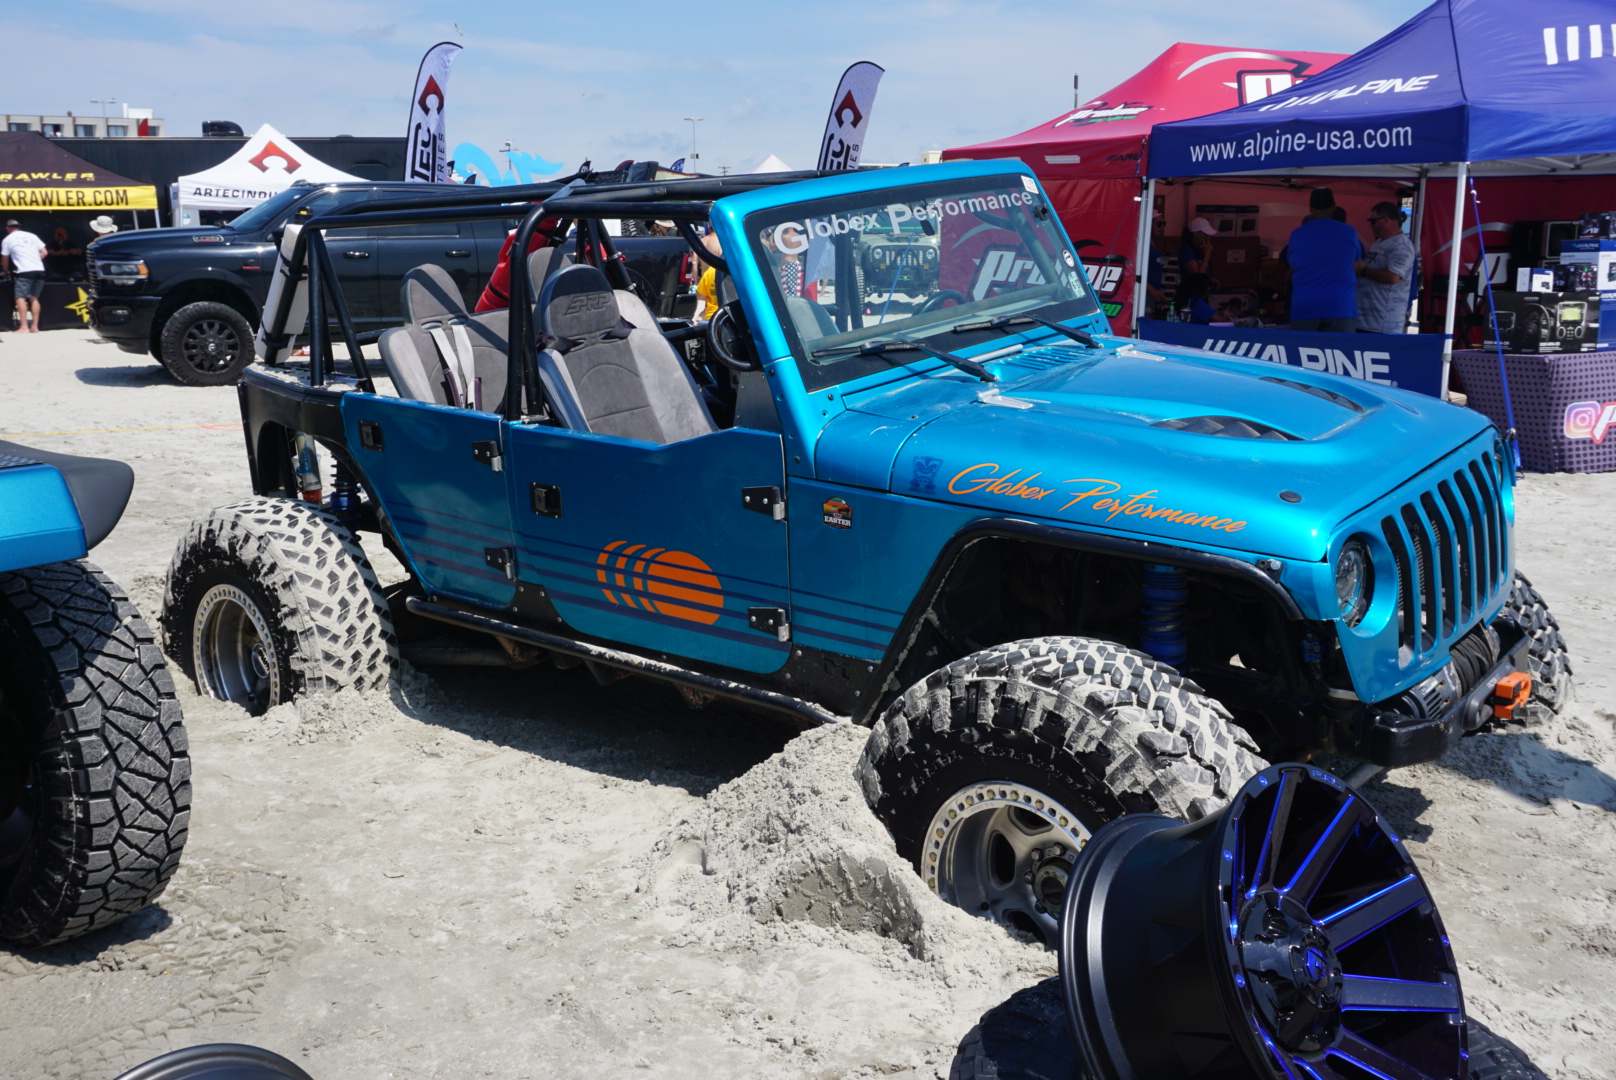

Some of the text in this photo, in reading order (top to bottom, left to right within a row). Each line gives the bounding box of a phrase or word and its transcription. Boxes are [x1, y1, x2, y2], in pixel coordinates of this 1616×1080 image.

[1308, 74, 1439, 104] ALPINE
[1190, 125, 1412, 162] www.alpine-usa.com
[773, 191, 1033, 255] Globex Performance
[947, 462, 1248, 532] Globex Performance
[824, 515, 851, 527] EASTER
